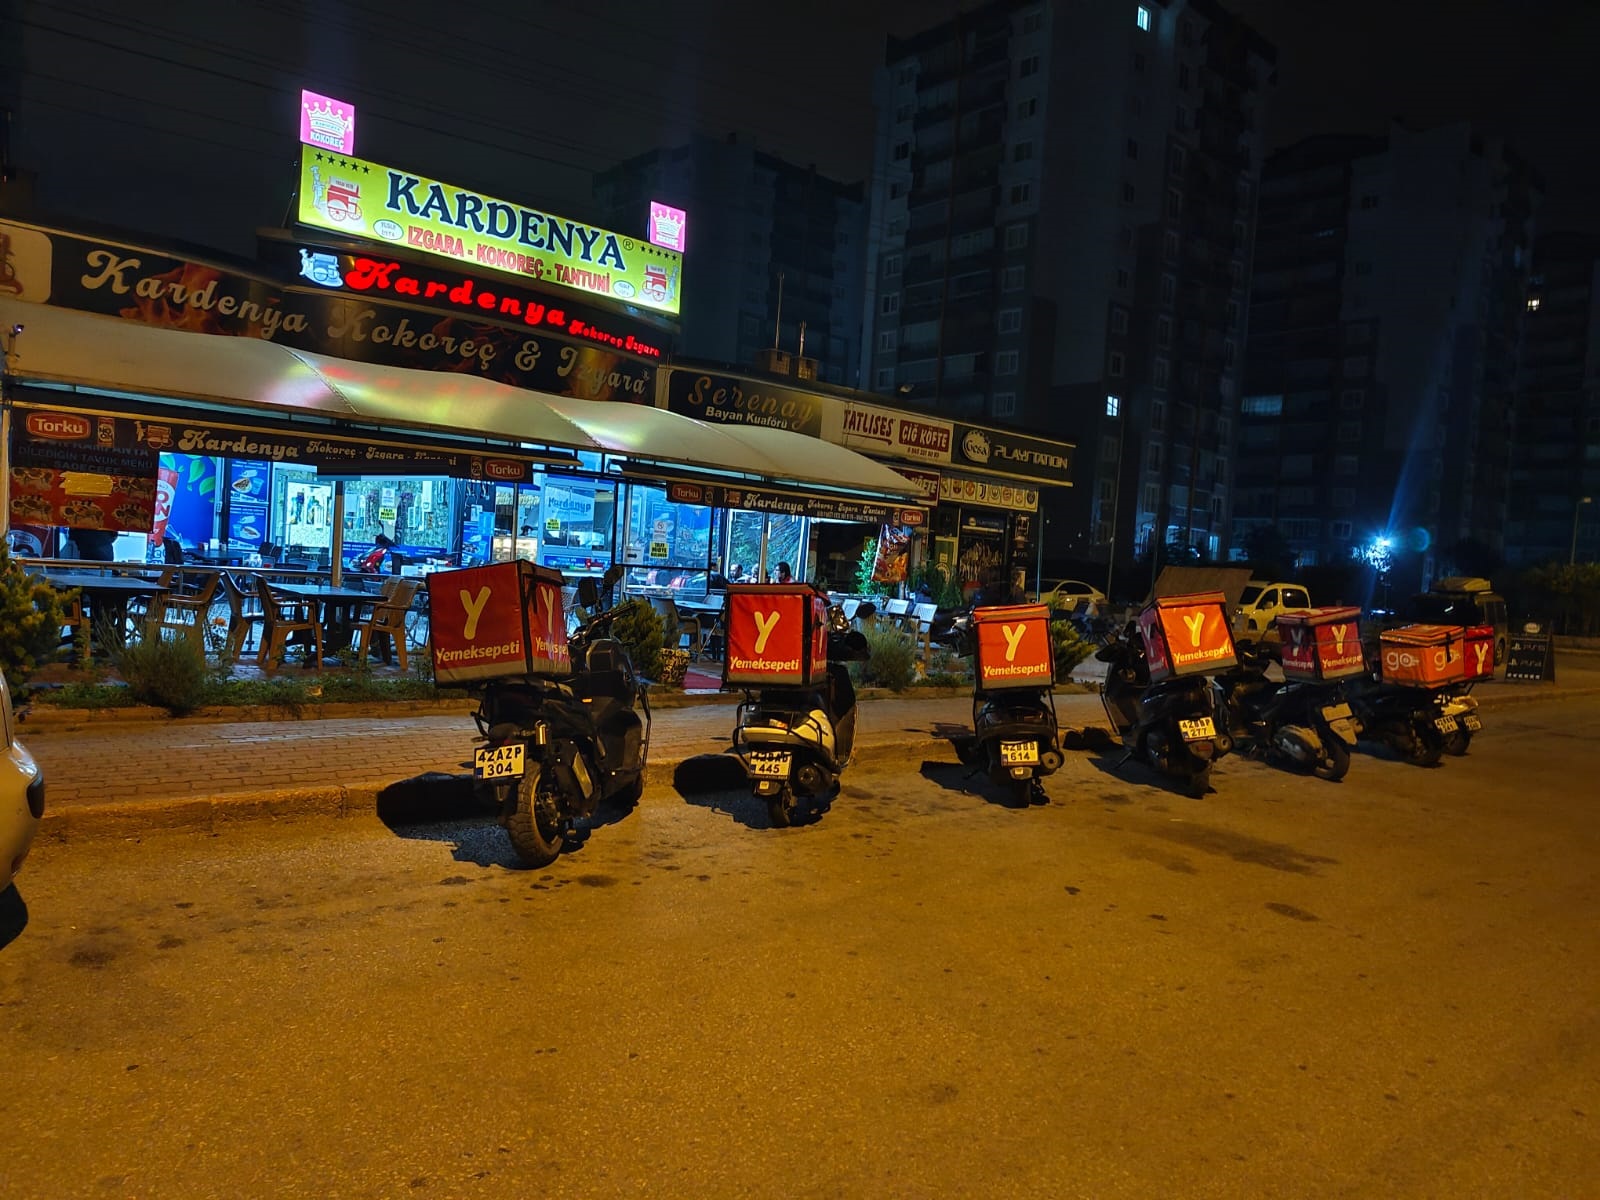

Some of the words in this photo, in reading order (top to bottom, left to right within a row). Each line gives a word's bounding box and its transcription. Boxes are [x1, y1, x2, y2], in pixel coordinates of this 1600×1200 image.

[310, 131, 345, 150] KOKOREÇ
[386, 170, 627, 271] KARDENYA
[407, 225, 465, 258] IZGARA
[477, 244, 544, 280] KOKOREÇ
[555, 263, 610, 294] TANTUNİ
[345, 259, 565, 326] Kardenya
[81, 250, 309, 341] Kardenya
[327, 306, 497, 371] Kokoreç
[514, 340, 542, 372] &
[688, 376, 813, 431] Serenay
[35, 418, 84, 434] Torku
[705, 406, 743, 422] Bayan
[746, 412, 788, 429] Kuaförü
[843, 409, 894, 438] TATLISES
[178, 429, 300, 460] Kardenya
[305, 441, 357, 457] Kokoreç
[365, 447, 404, 460] Izgara
[901, 422, 918, 444] ÇİĞ
[919, 426, 949, 449] KÖFTE
[490, 463, 521, 476] Torku
[993, 444, 1068, 470] PLAYSTATION
[677, 487, 699, 499] Torku
[744, 493, 804, 514] Kardenya
[460, 586, 491, 640] Y
[754, 610, 781, 654] Y
[1002, 623, 1026, 661] Y
[1183, 612, 1205, 647] Y
[1331, 624, 1347, 655] Y
[436, 640, 520, 664] Yemeksepeti
[730, 656, 800, 672] Yemeksepeti
[1173, 642, 1232, 664] Yemeksepeti
[1474, 643, 1489, 675] Y
[984, 662, 1048, 678] Yemeksepeti
[1190, 728, 1207, 737] 277
[477, 747, 522, 763] 42AZP
[1010, 752, 1030, 761] 614
[487, 763, 513, 776] 304
[758, 764, 780, 774] 445
